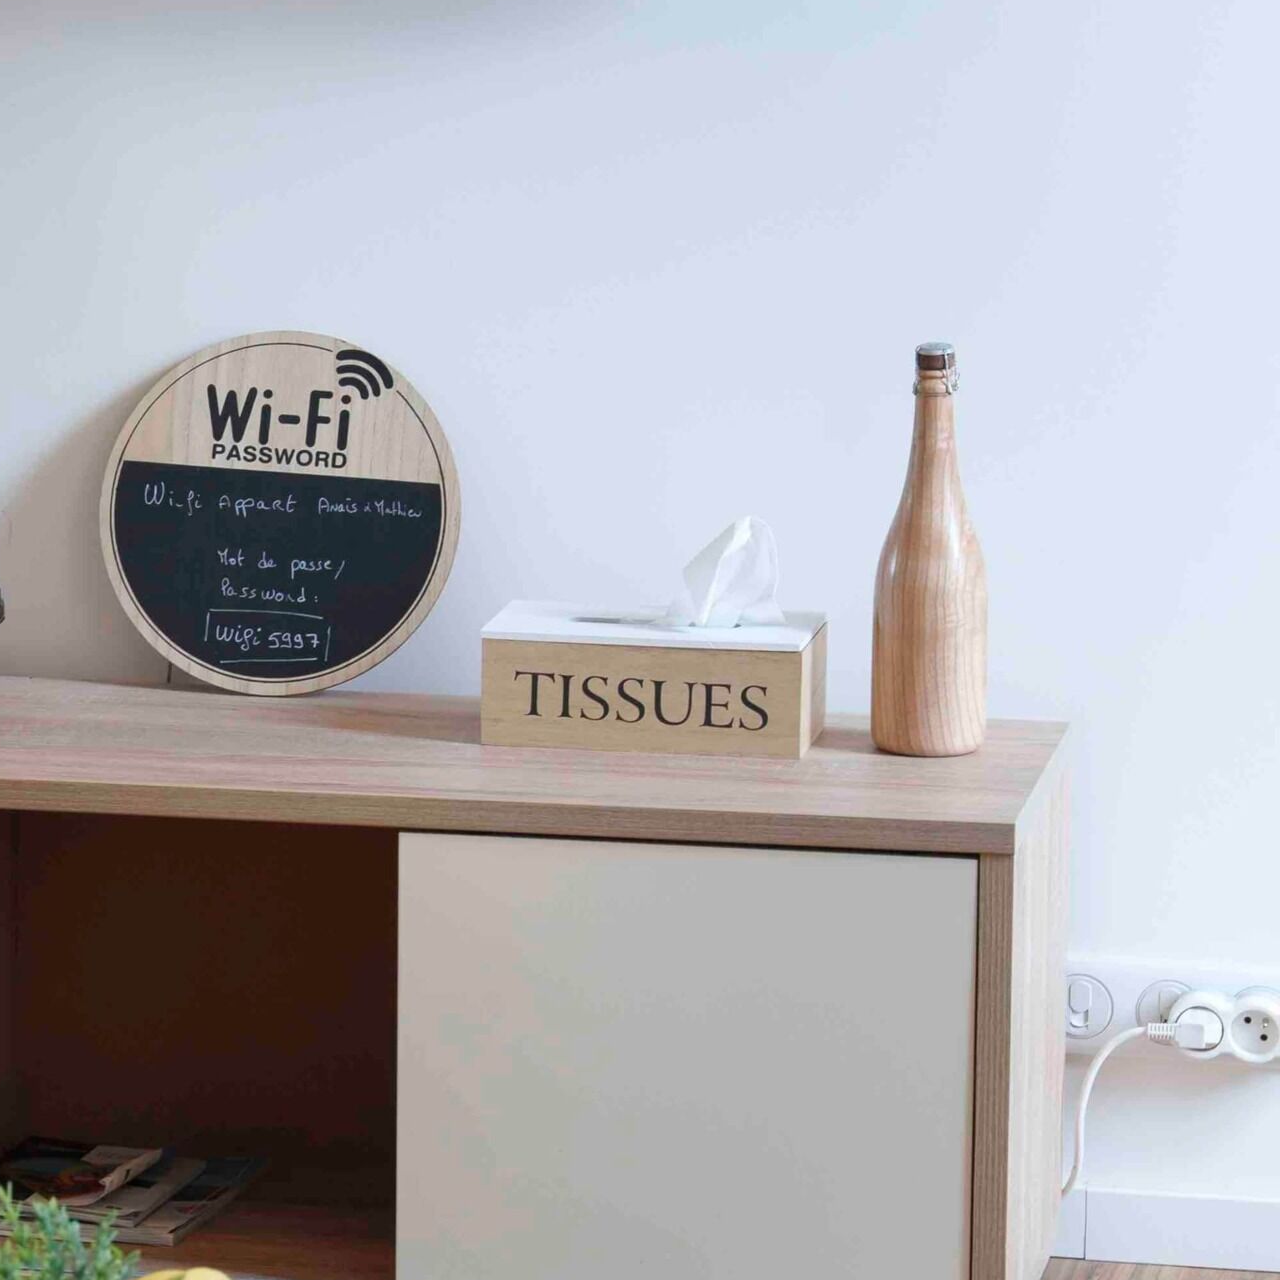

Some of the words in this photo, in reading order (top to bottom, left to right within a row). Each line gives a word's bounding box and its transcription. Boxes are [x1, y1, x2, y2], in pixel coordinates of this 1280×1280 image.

[207, 384, 351, 451] Wi-Fi
[211, 443, 348, 469] PASSWORD
[374, 499, 422, 518] Mathieu
[217, 548, 245, 566] Mot
[257, 551, 277, 568] de
[514, 670, 769, 732] TISSUES
